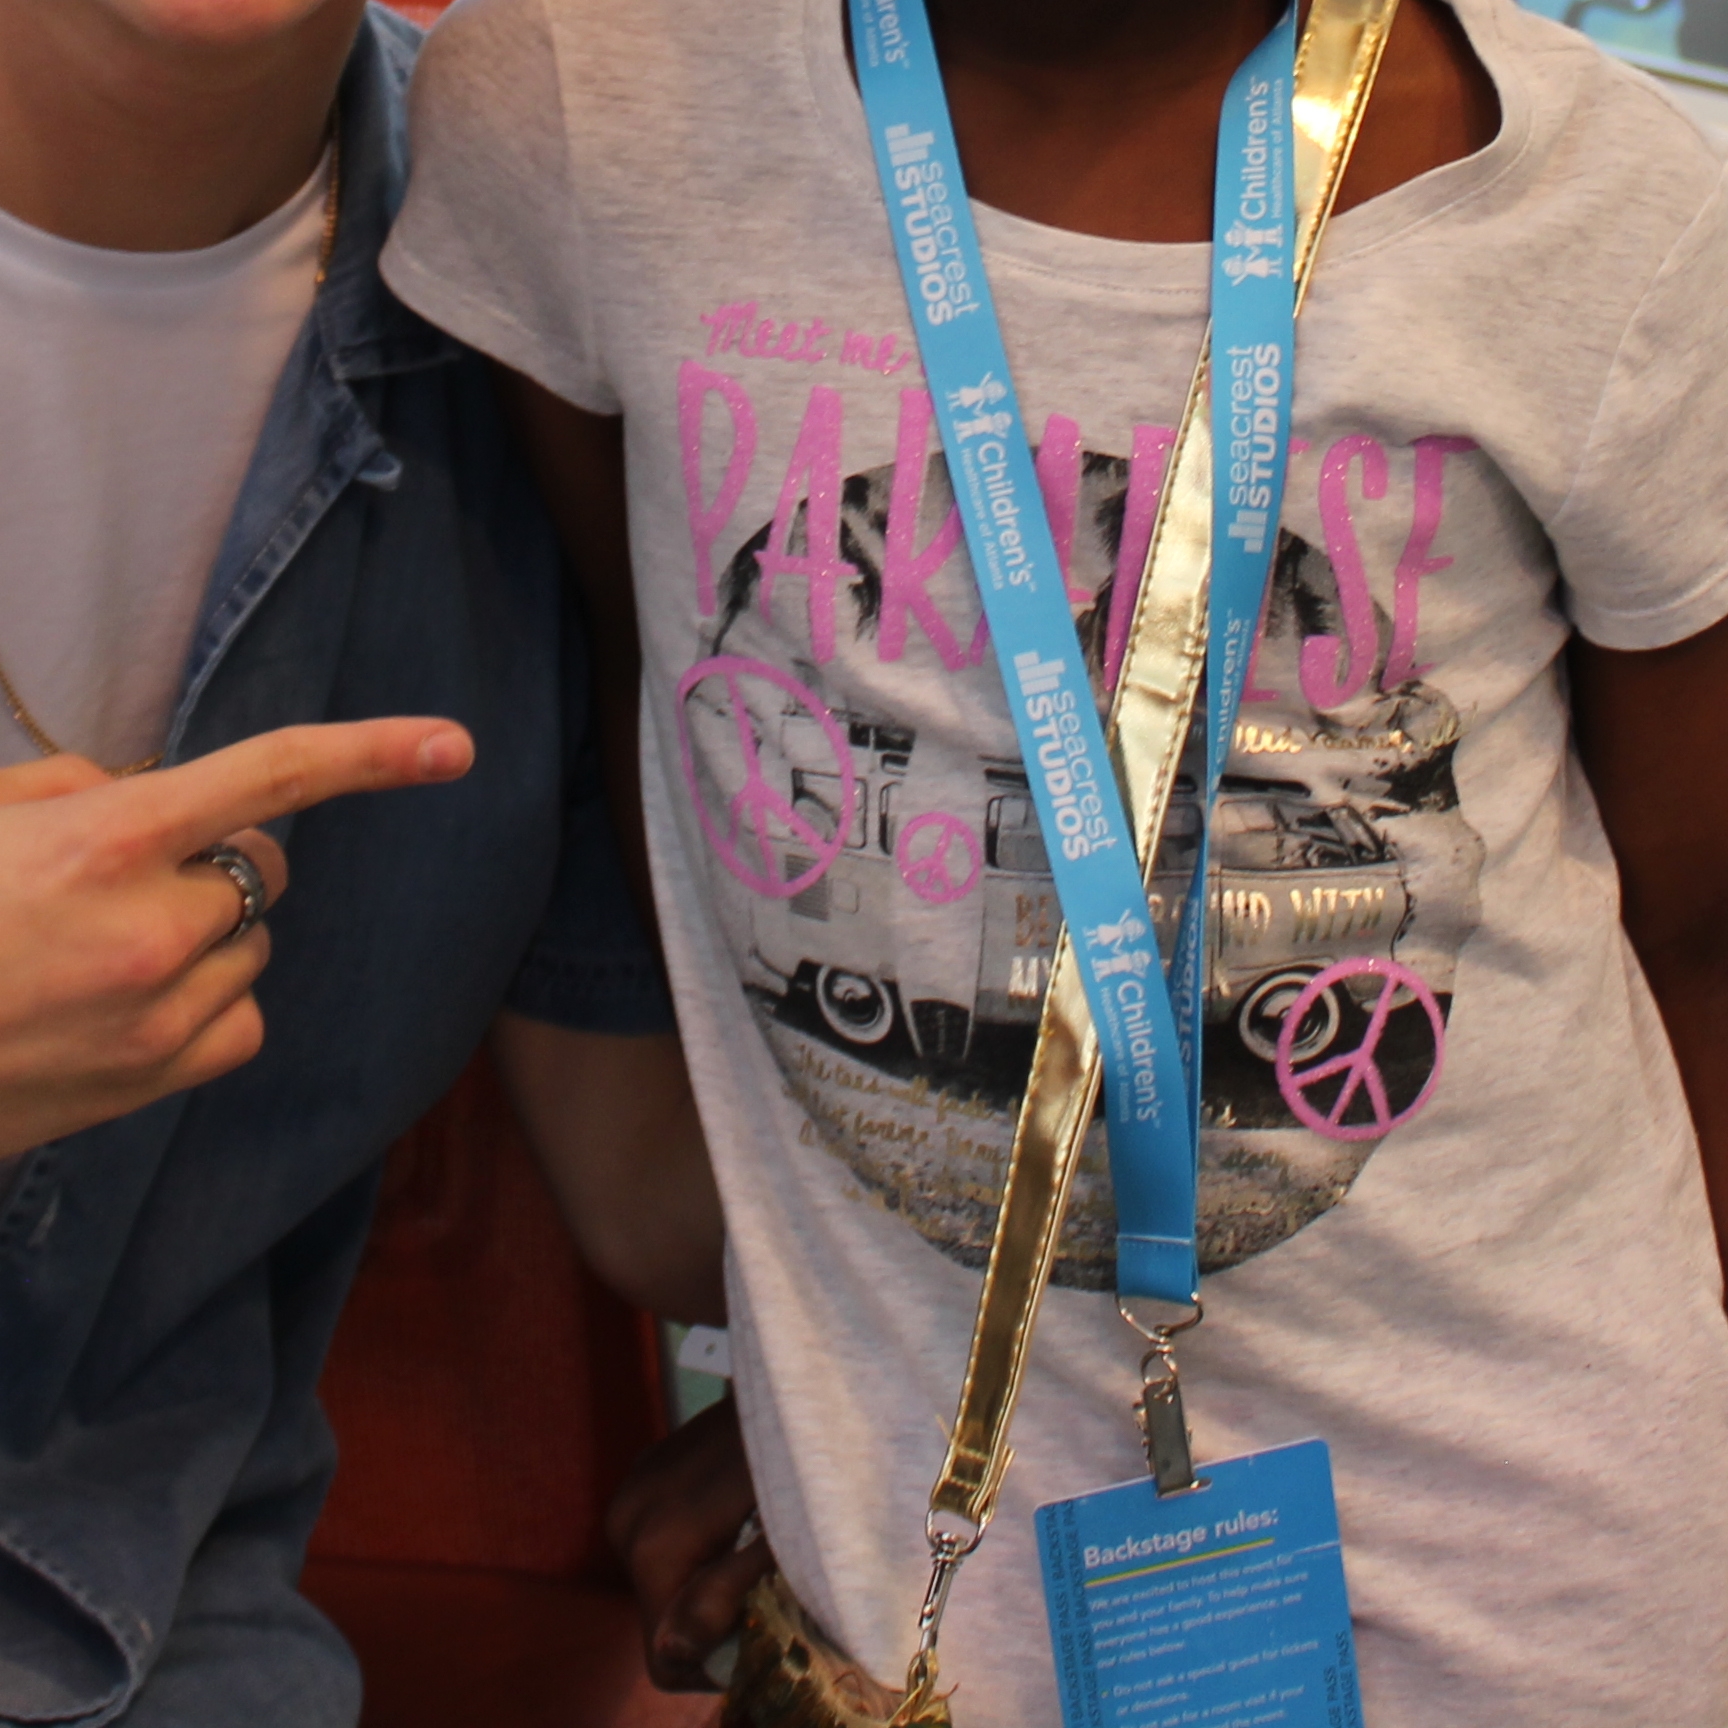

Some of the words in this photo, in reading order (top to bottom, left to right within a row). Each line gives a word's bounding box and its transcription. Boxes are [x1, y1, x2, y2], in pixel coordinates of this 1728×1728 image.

[1240, 80, 1270, 220] Children's
[895, 165, 954, 327] STUDIOS
[922, 160, 981, 318] seacrest
[699, 301, 831, 362] Meet
[839, 329, 913, 375] me
[1226, 345, 1254, 506] seacrest
[1248, 342, 1281, 509] STUDIOS
[978, 441, 1036, 587] Children's
[1026, 696, 1091, 861] STUDIOS
[1052, 690, 1118, 854] seacrest
[1290, 886, 1384, 943] WITH
[1117, 980, 1163, 1122] Children's
[1083, 1526, 1208, 1569] Backstage
[1214, 1508, 1280, 1539] rules:
